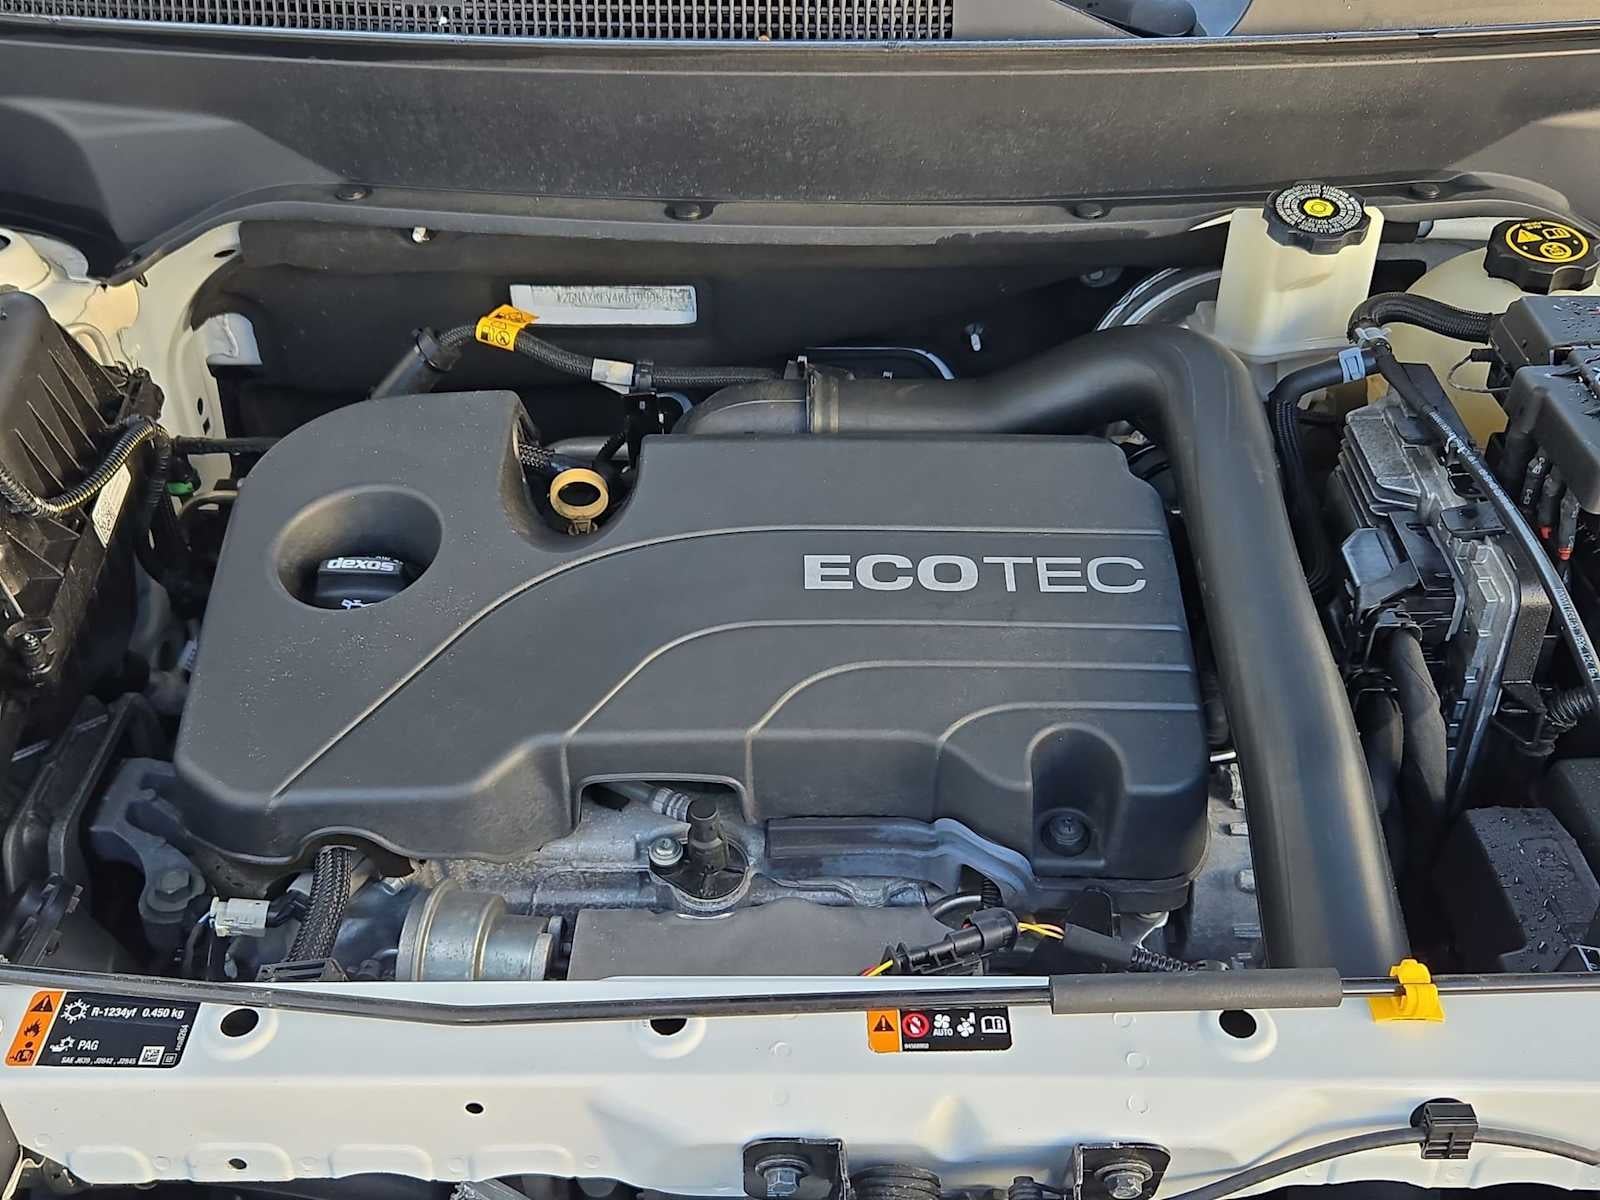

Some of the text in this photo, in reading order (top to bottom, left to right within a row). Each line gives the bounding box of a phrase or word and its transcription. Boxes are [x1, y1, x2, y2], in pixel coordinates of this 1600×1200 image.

[327, 557, 396, 572] dexos
[803, 553, 1146, 594] ECOTEC
[91, 1007, 184, 1019] R-1234yf 0.450 kg
[933, 1028, 953, 1037] AUTO
[77, 1039, 99, 1051] PAG
[61, 1056, 75, 1064] SAE
